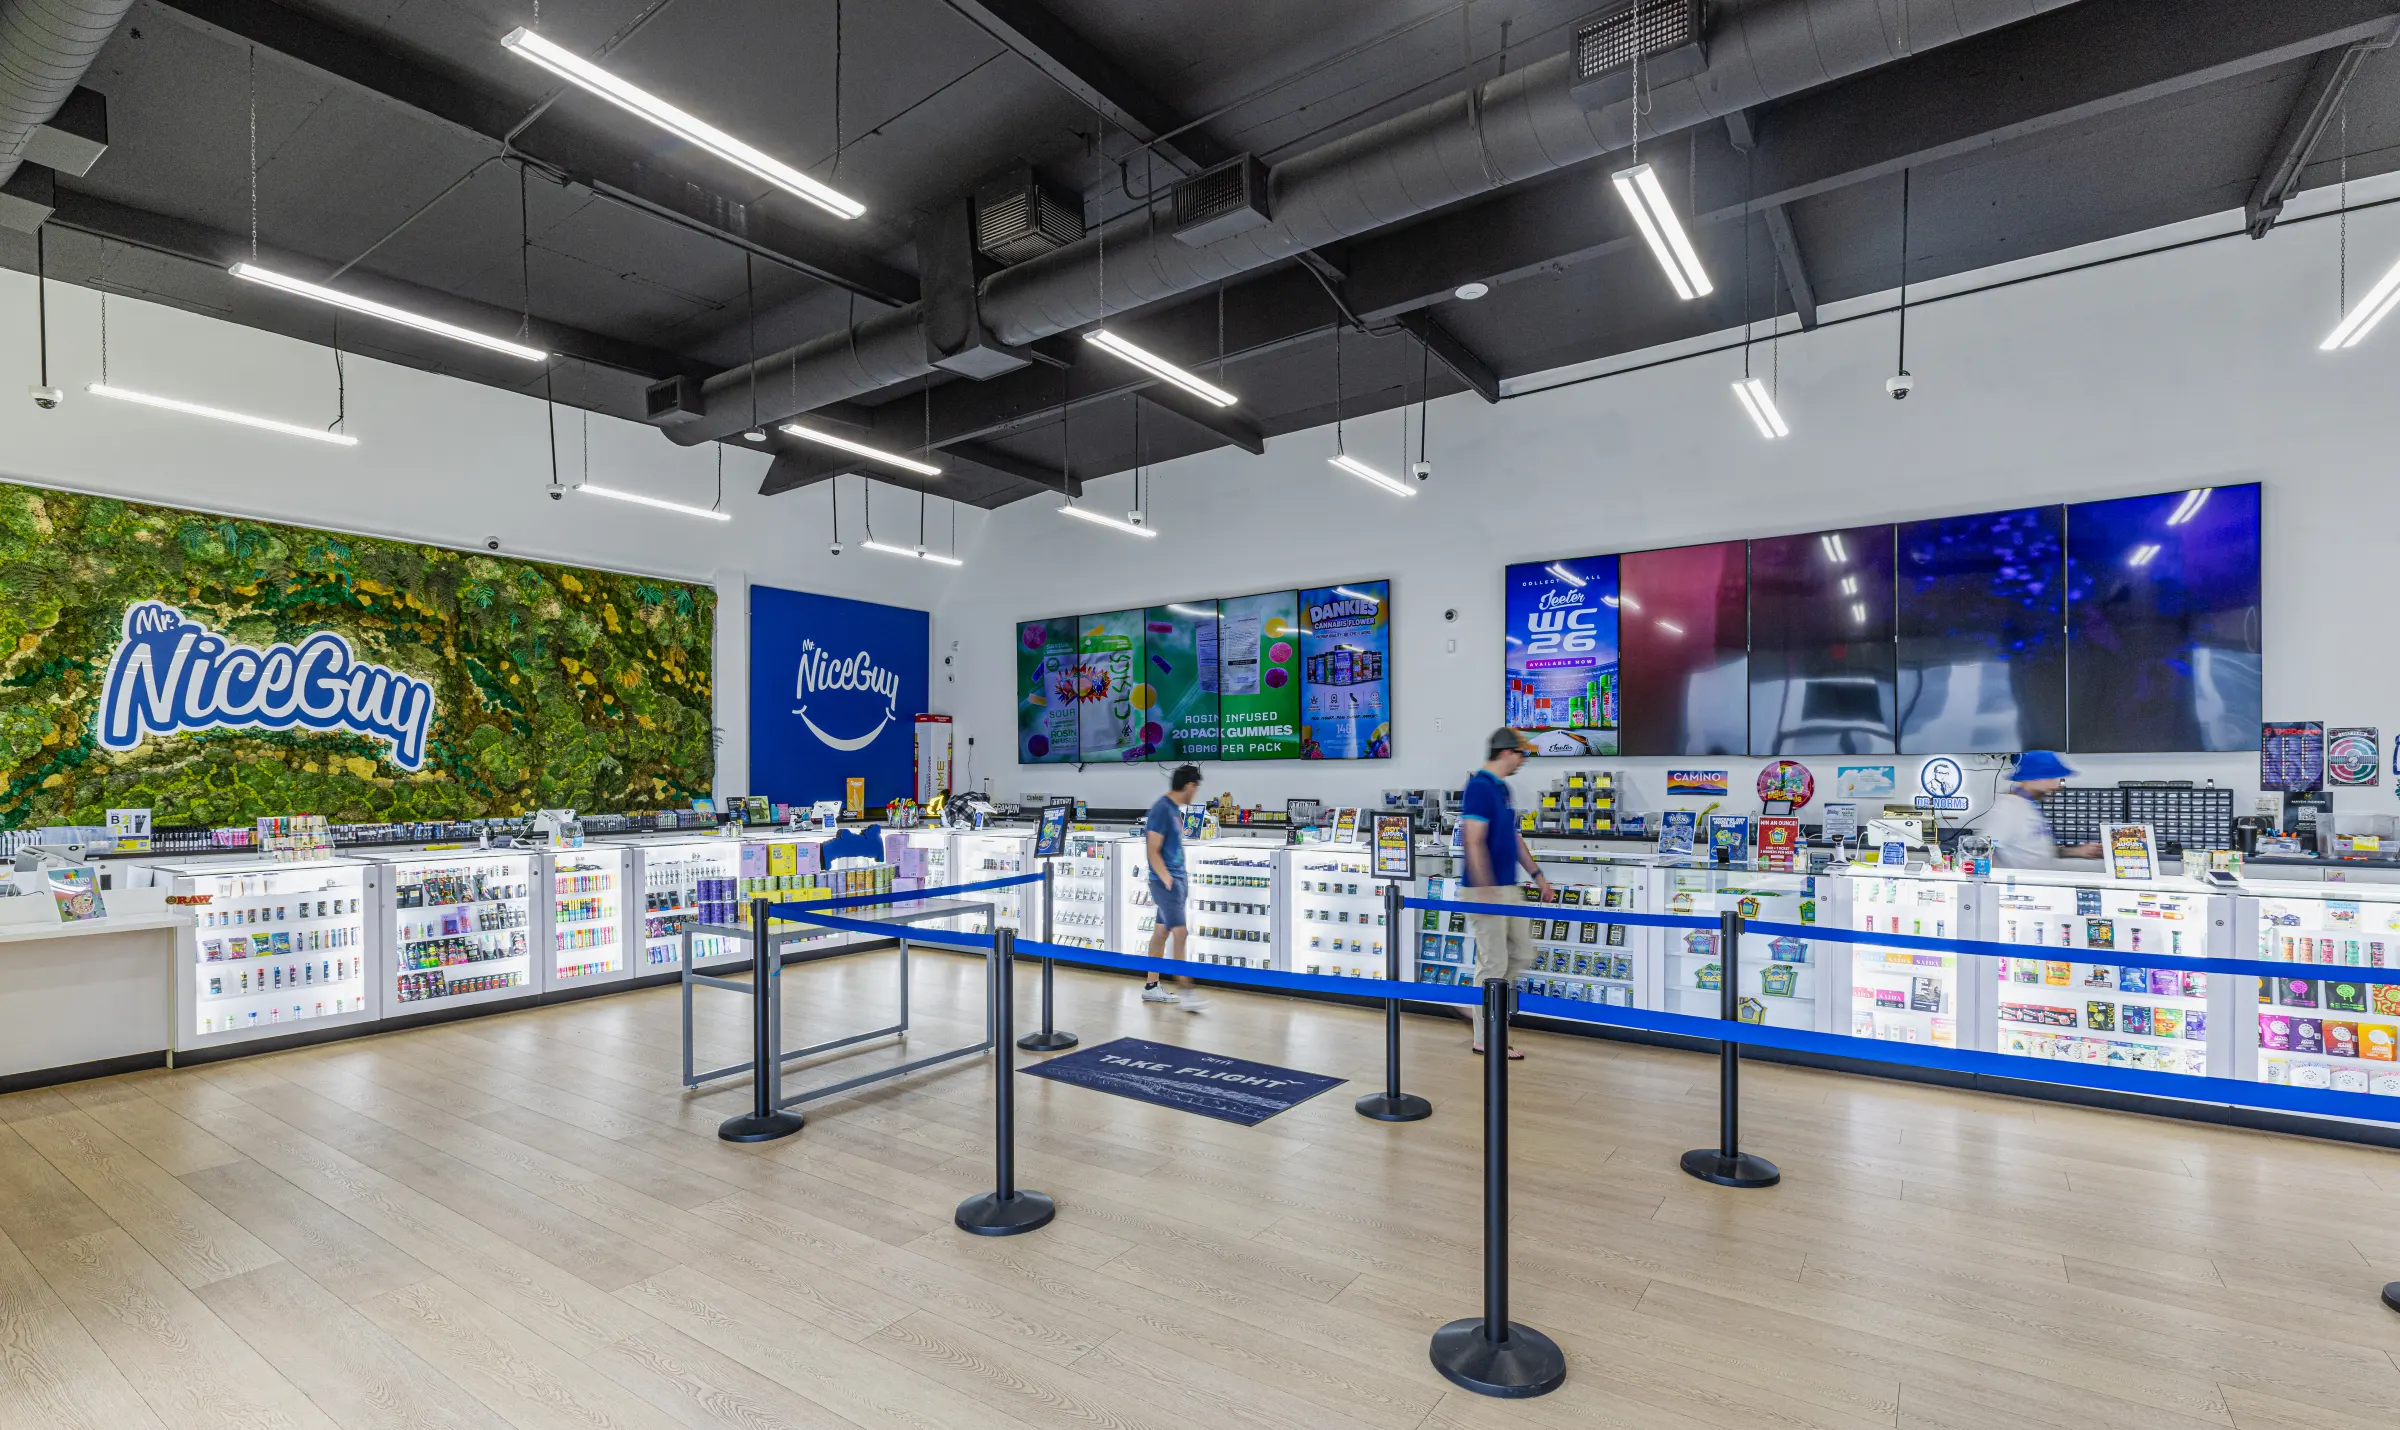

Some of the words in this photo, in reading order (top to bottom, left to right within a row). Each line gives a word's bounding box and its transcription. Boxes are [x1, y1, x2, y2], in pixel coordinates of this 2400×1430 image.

[1522, 578, 1560, 587] COLLECT
[1538, 588, 1585, 610] Jeeter
[1309, 599, 1379, 623] DANKIES
[135, 606, 176, 635] Mr.
[1314, 619, 1347, 630] CANNABIS
[1348, 617, 1375, 627] FLOWER
[1527, 608, 1598, 633] WC
[803, 638, 816, 652] Mr.
[1527, 630, 1598, 655] 26
[1529, 660, 1572, 668] AVAILABLE
[796, 647, 899, 711] NiceGuy
[112, 632, 427, 759] NiceGuy
[1049, 708, 1076, 719] SOUR
[1185, 715, 1220, 724] ROSIN
[1225, 711, 1278, 723] INFUSED
[1050, 729, 1077, 738] ROSIN
[1172, 728, 1190, 739] 20
[1190, 727, 1225, 738] PACK
[1224, 725, 1293, 738] GUMMIES
[1336, 723, 1352, 734] 14G
[1182, 744, 1219, 754] 100MG
[1222, 743, 1245, 753] PER
[1249, 742, 1282, 753] PACK
[1673, 772, 1721, 782] CAMINO
[177, 895, 213, 904] RAW
[1099, 1054, 1173, 1072] TAKE
[1174, 1067, 1288, 1088] FLIGHT
